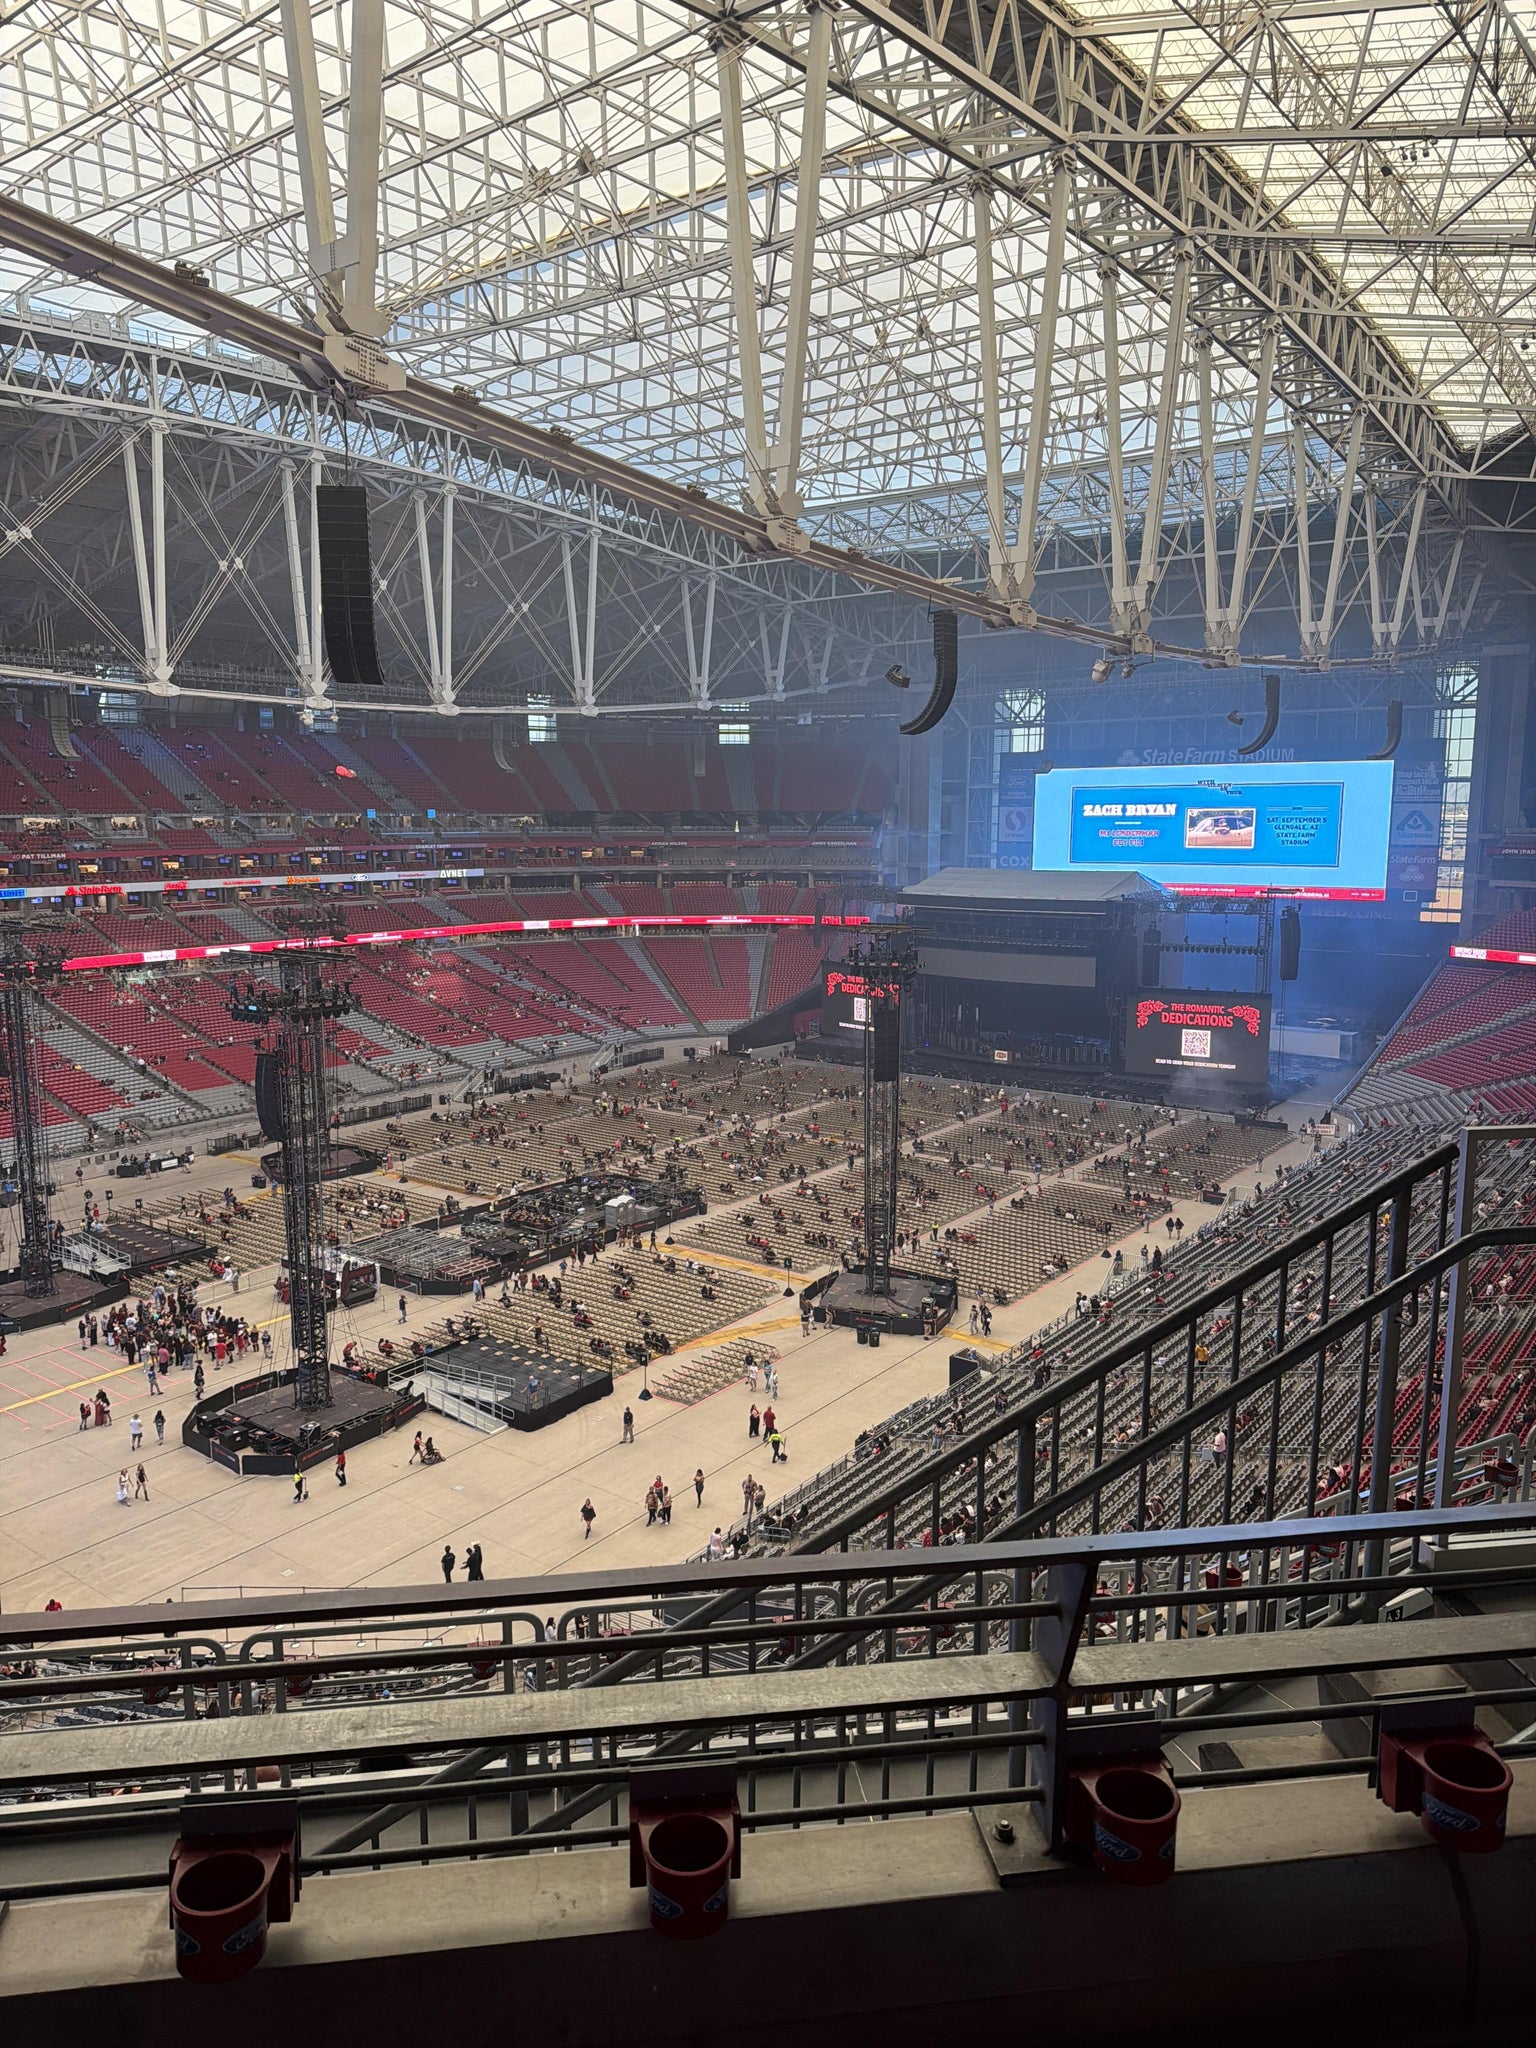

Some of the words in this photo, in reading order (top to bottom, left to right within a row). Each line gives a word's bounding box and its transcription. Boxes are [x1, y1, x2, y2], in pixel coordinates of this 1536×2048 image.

[1228, 748, 1294, 763] STADIUM
[1083, 804, 1123, 816] ZACH
[1125, 803, 1177, 816] BRYAN
[1000, 855, 1029, 867] COX
[1171, 1003, 1185, 1012] THE
[1185, 1003, 1225, 1014] ROMANTIC
[1161, 1012, 1234, 1028] DEDICATIONS
[1394, 1609, 1400, 1620] 3
